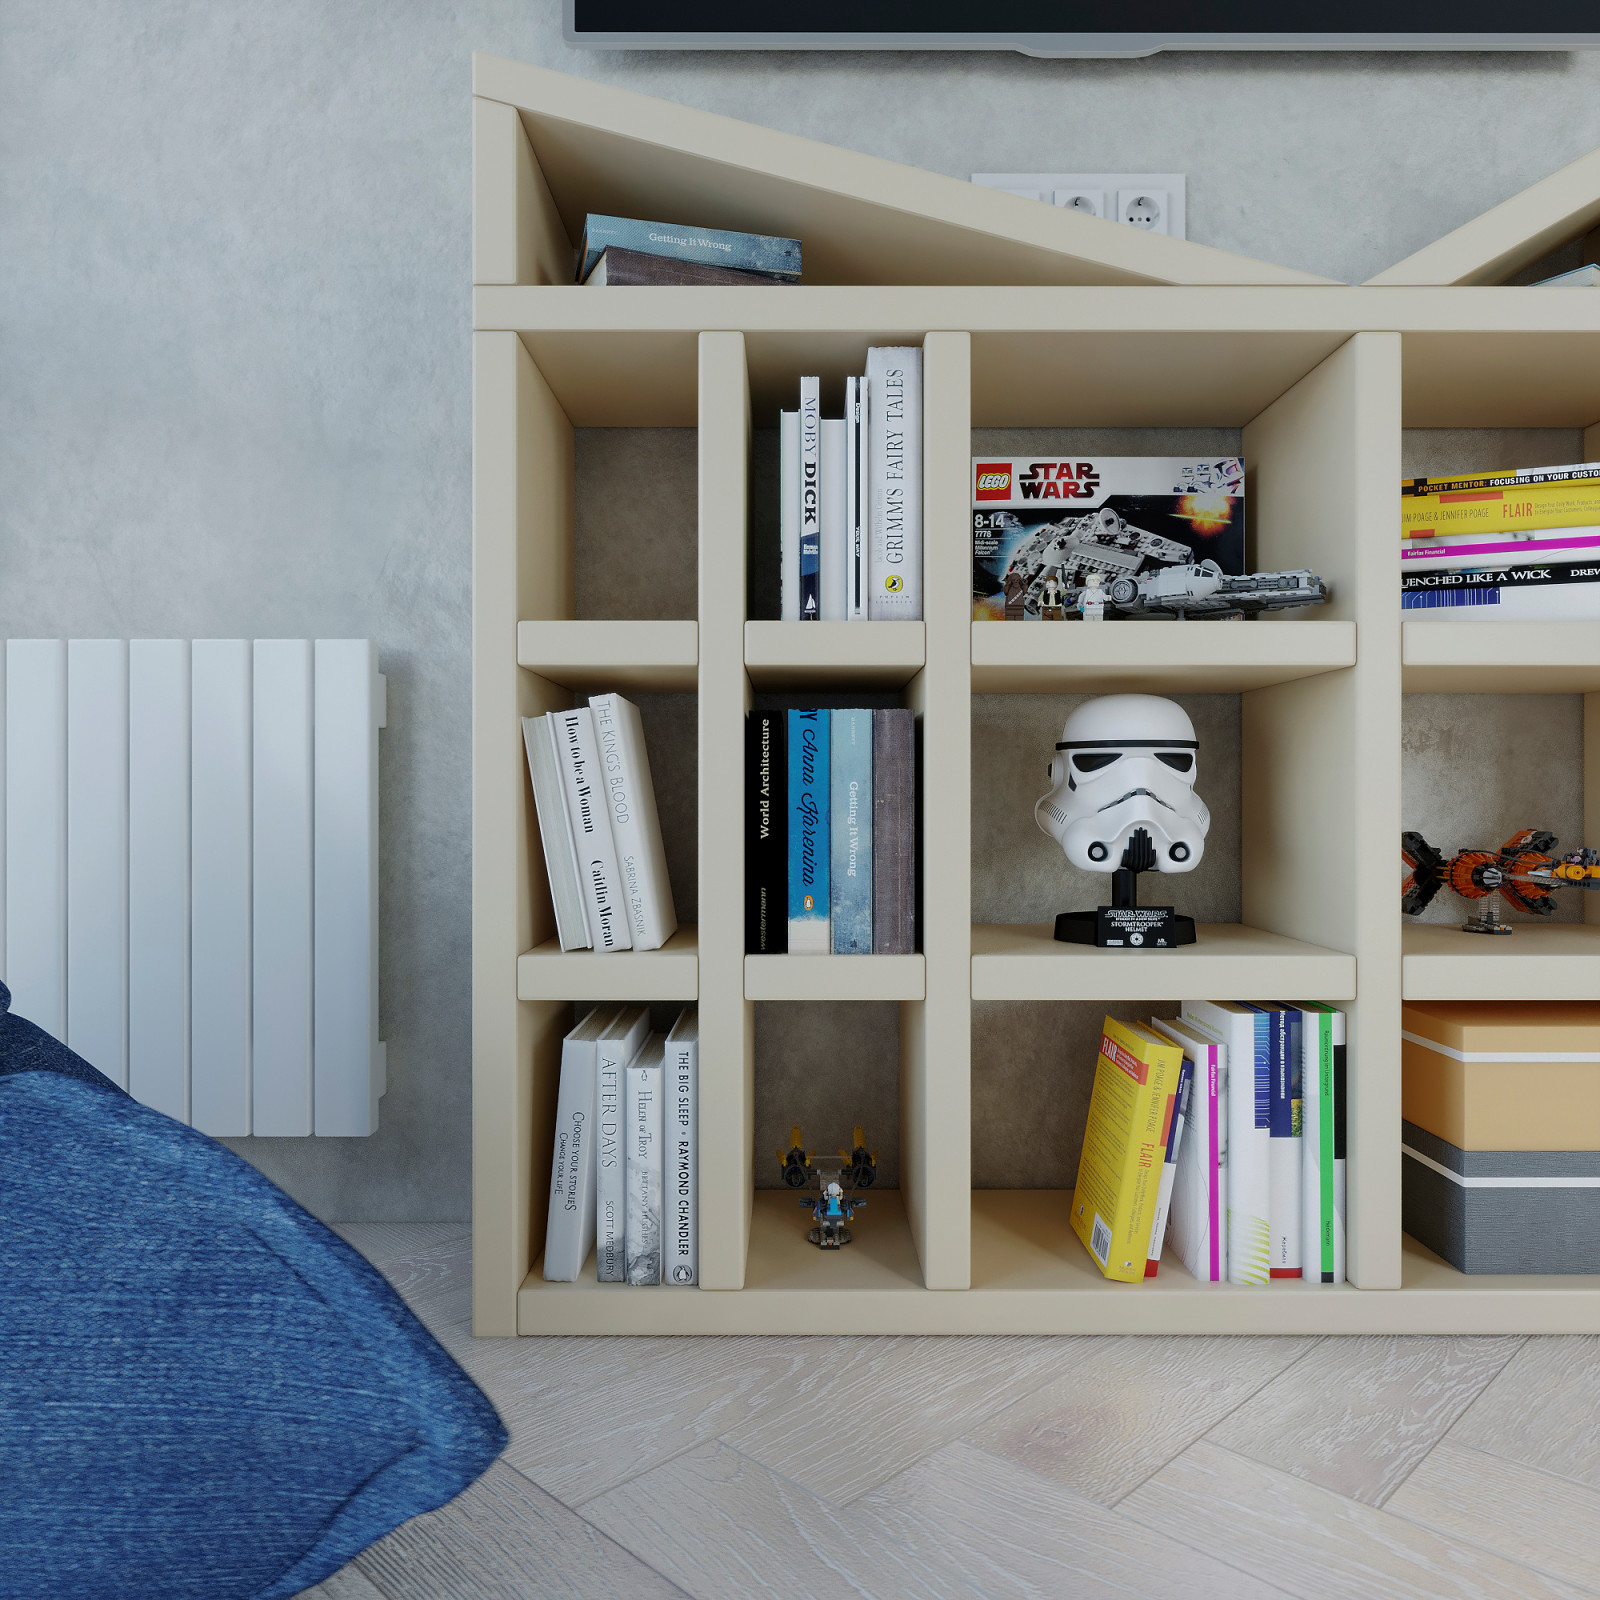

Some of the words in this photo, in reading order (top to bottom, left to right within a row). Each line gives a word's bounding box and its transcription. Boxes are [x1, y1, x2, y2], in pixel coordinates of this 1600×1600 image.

[649, 233, 688, 247] Getting
[689, 237, 698, 246] It
[698, 239, 732, 252] Wrong
[886, 369, 904, 421] TALES
[804, 397, 817, 458] MOBY
[886, 429, 904, 480] FAIRY
[978, 474, 1009, 489] LEGO
[1019, 463, 1099, 479] STAR
[1418, 484, 1448, 493] POCKET
[1451, 480, 1487, 490] MENTOR:
[1489, 475, 1530, 487] FOCUSING
[1533, 474, 1544, 483] ON
[1547, 472, 1569, 481] YOUR
[1571, 469, 1600, 479] CUSTO
[804, 462, 817, 525] DICK
[1020, 482, 1099, 499] WARS
[974, 514, 1005, 528] 8-14
[1413, 511, 1433, 522] POAGE
[1434, 511, 1439, 521] &
[1440, 509, 1468, 521] JENNIFER
[1469, 508, 1489, 519] POAGE
[1503, 503, 1533, 519] FLAIR
[886, 488, 904, 564] GRIMM'S
[974, 530, 992, 538] 7778
[1407, 549, 1424, 557] Fairfax
[1425, 548, 1446, 556] Financial
[1466, 573, 1493, 584] LIKE
[1496, 573, 1508, 582] A
[1511, 569, 1551, 581] WICK
[597, 700, 613, 726] THE
[565, 716, 580, 744] How
[570, 747, 581, 759] to
[602, 730, 621, 772] KING'S
[760, 718, 770, 797] Architecture
[802, 729, 818, 786] Anna
[573, 760, 585, 775] be
[576, 777, 585, 785] a
[578, 785, 594, 833] Woman
[610, 776, 630, 824] BLOOD
[847, 781, 858, 825] Getting
[760, 800, 770, 840] World
[849, 827, 858, 837] It
[847, 837, 859, 877] Wrong
[590, 859, 608, 904] Caitlin
[623, 855, 638, 896] SABRINA
[631, 898, 646, 937] ZBASNIK
[598, 905, 614, 947] Moran
[1104, 909, 1136, 918] STAR
[678, 1051, 689, 1071] THE
[601, 1058, 617, 1117] AFTER
[678, 1074, 689, 1093] BIG
[638, 1091, 653, 1122] HELEN
[678, 1097, 689, 1126] SLEEP
[572, 1111, 585, 1148] CHOOSE
[558, 1132, 568, 1160] CHANGE
[601, 1123, 617, 1168] DAYS
[638, 1133, 652, 1159] TROY
[1138, 1142, 1155, 1169] FLAIR
[557, 1161, 565, 1178] YOUR
[570, 1150, 579, 1173] YOUR
[678, 1141, 689, 1196] RAYMOND
[554, 1179, 564, 1195] LIFE
[565, 1175, 577, 1211] STORIES
[605, 1200, 614, 1229] SCOTT
[678, 1200, 689, 1256] CHANDLER
[605, 1231, 614, 1276] MEDBURY
